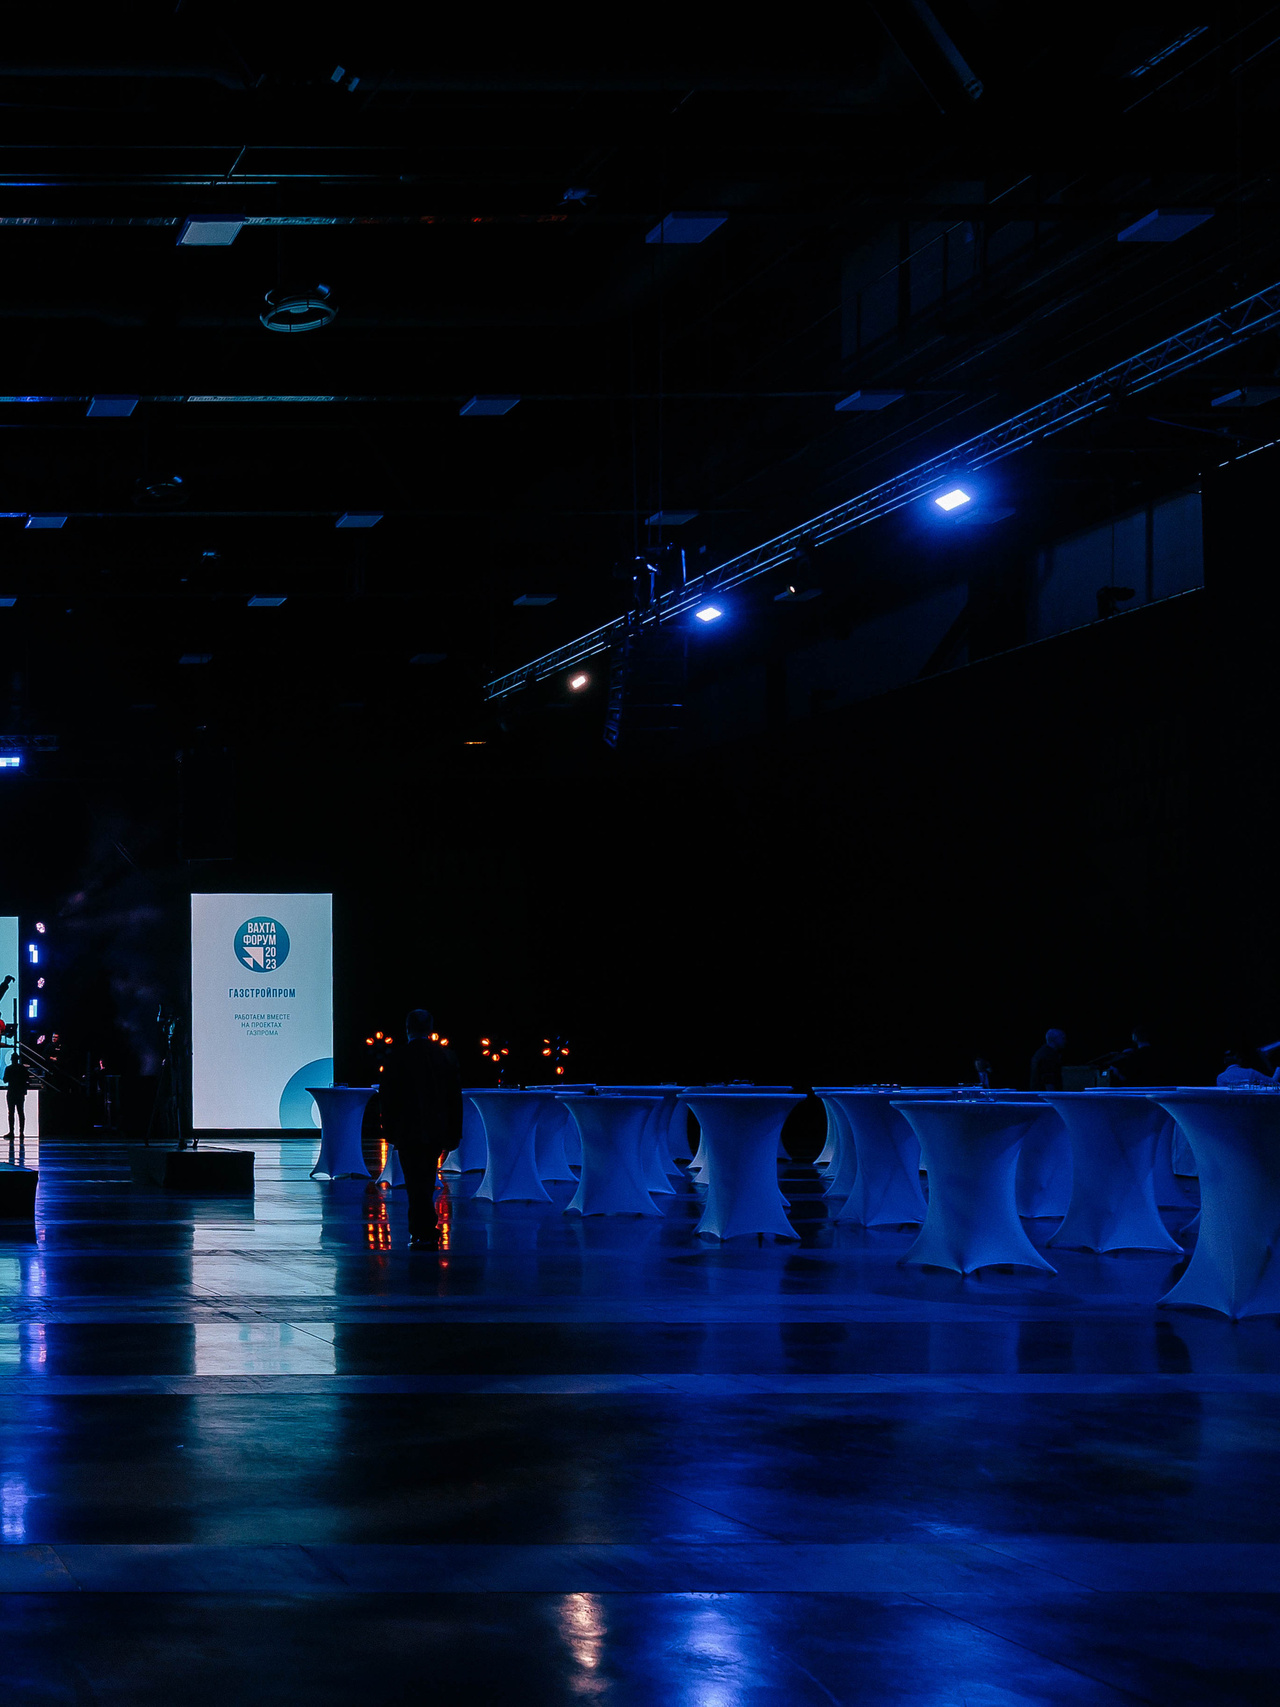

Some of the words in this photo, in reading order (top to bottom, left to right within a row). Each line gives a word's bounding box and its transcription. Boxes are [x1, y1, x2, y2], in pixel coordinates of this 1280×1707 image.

[247, 922, 276, 933] ВАХТА
[243, 934, 276, 945] ФОРУМ
[265, 946, 276, 957] 20
[265, 958, 277, 969] 23
[228, 987, 296, 998] ГАЗСТРОЙПРОМ
